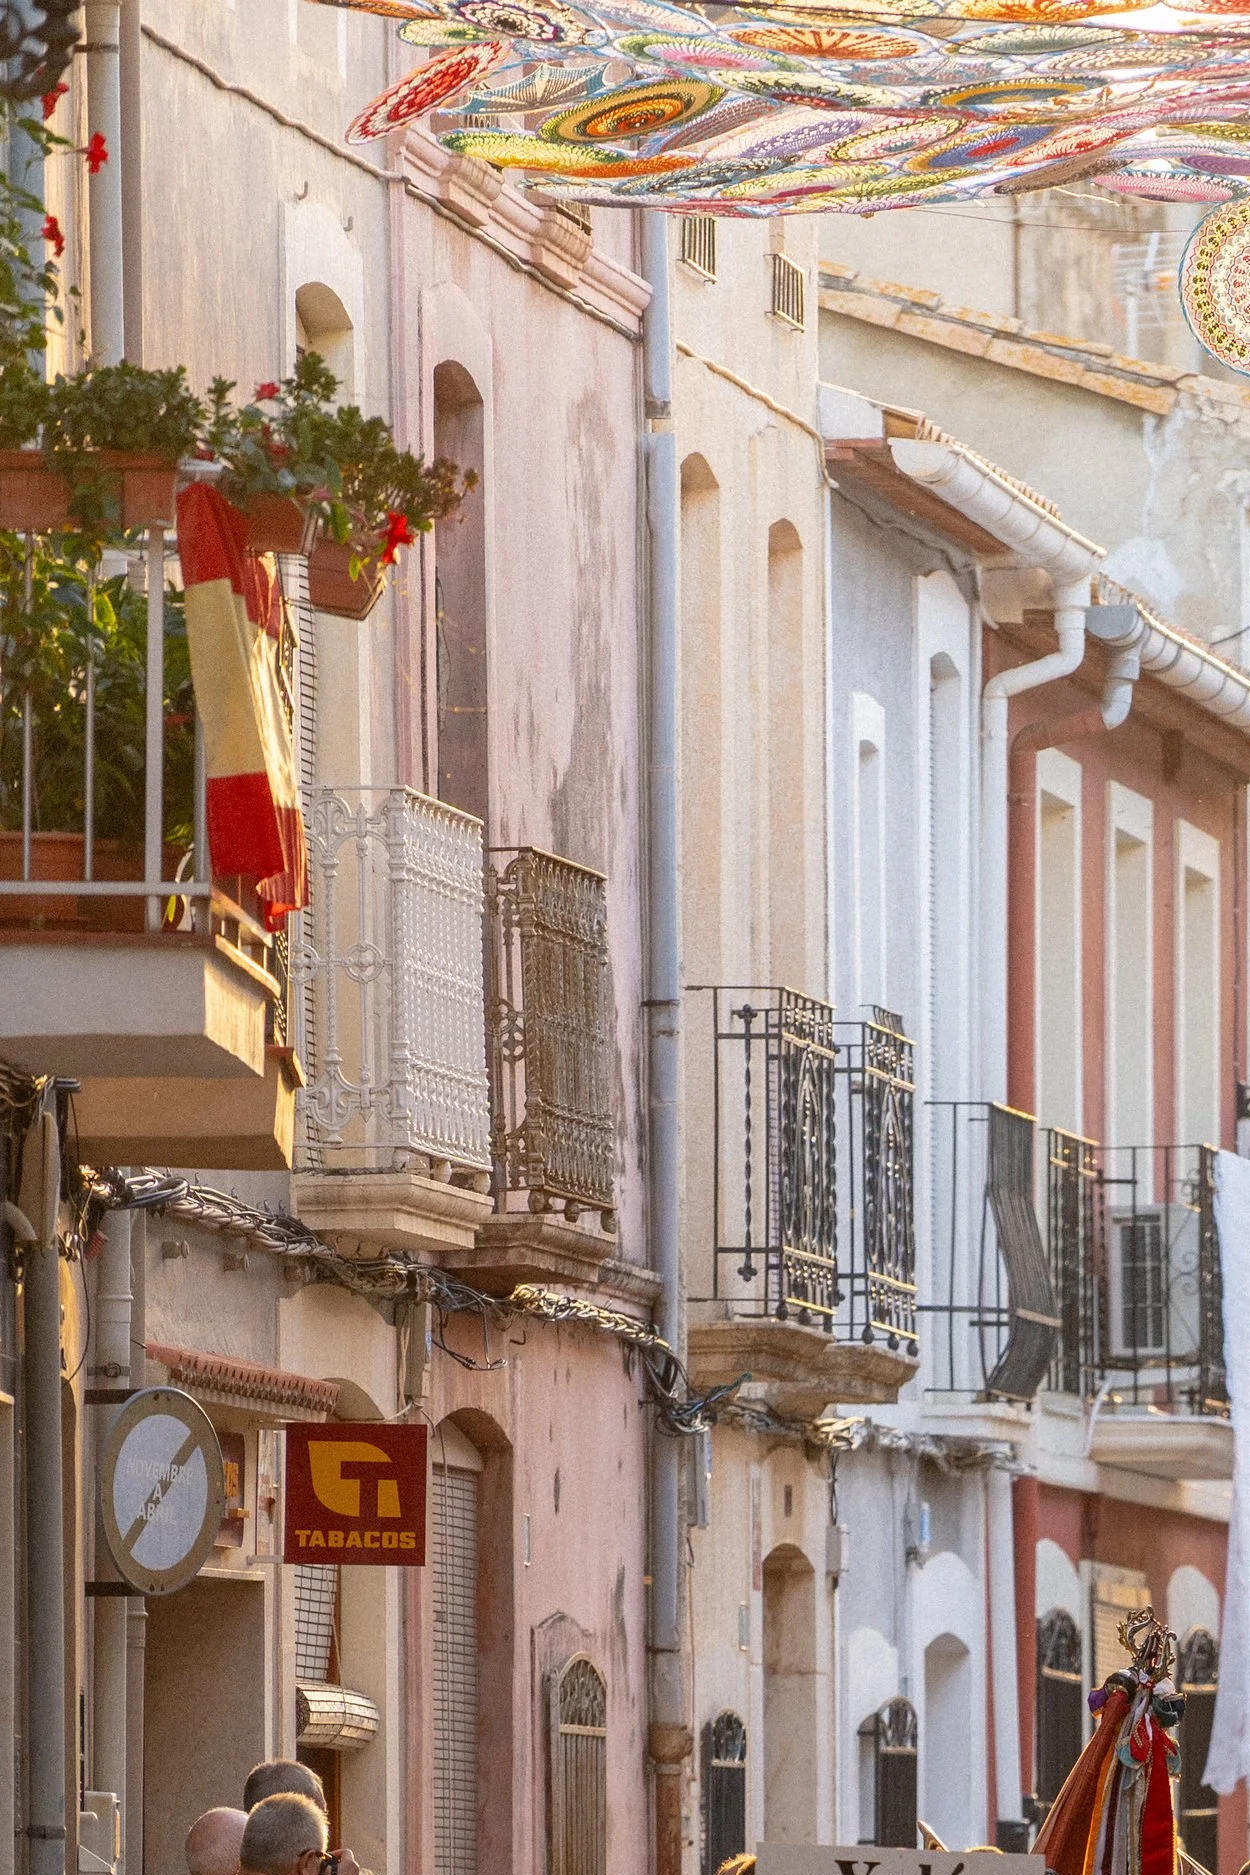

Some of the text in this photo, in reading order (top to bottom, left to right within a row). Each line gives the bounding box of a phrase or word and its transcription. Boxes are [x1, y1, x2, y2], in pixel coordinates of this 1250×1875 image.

[125, 1457, 193, 1485] NOVEMBRE
[152, 1483, 163, 1502] A
[137, 1502, 177, 1525] ABRIL
[294, 1529, 417, 1549] TABACOS
